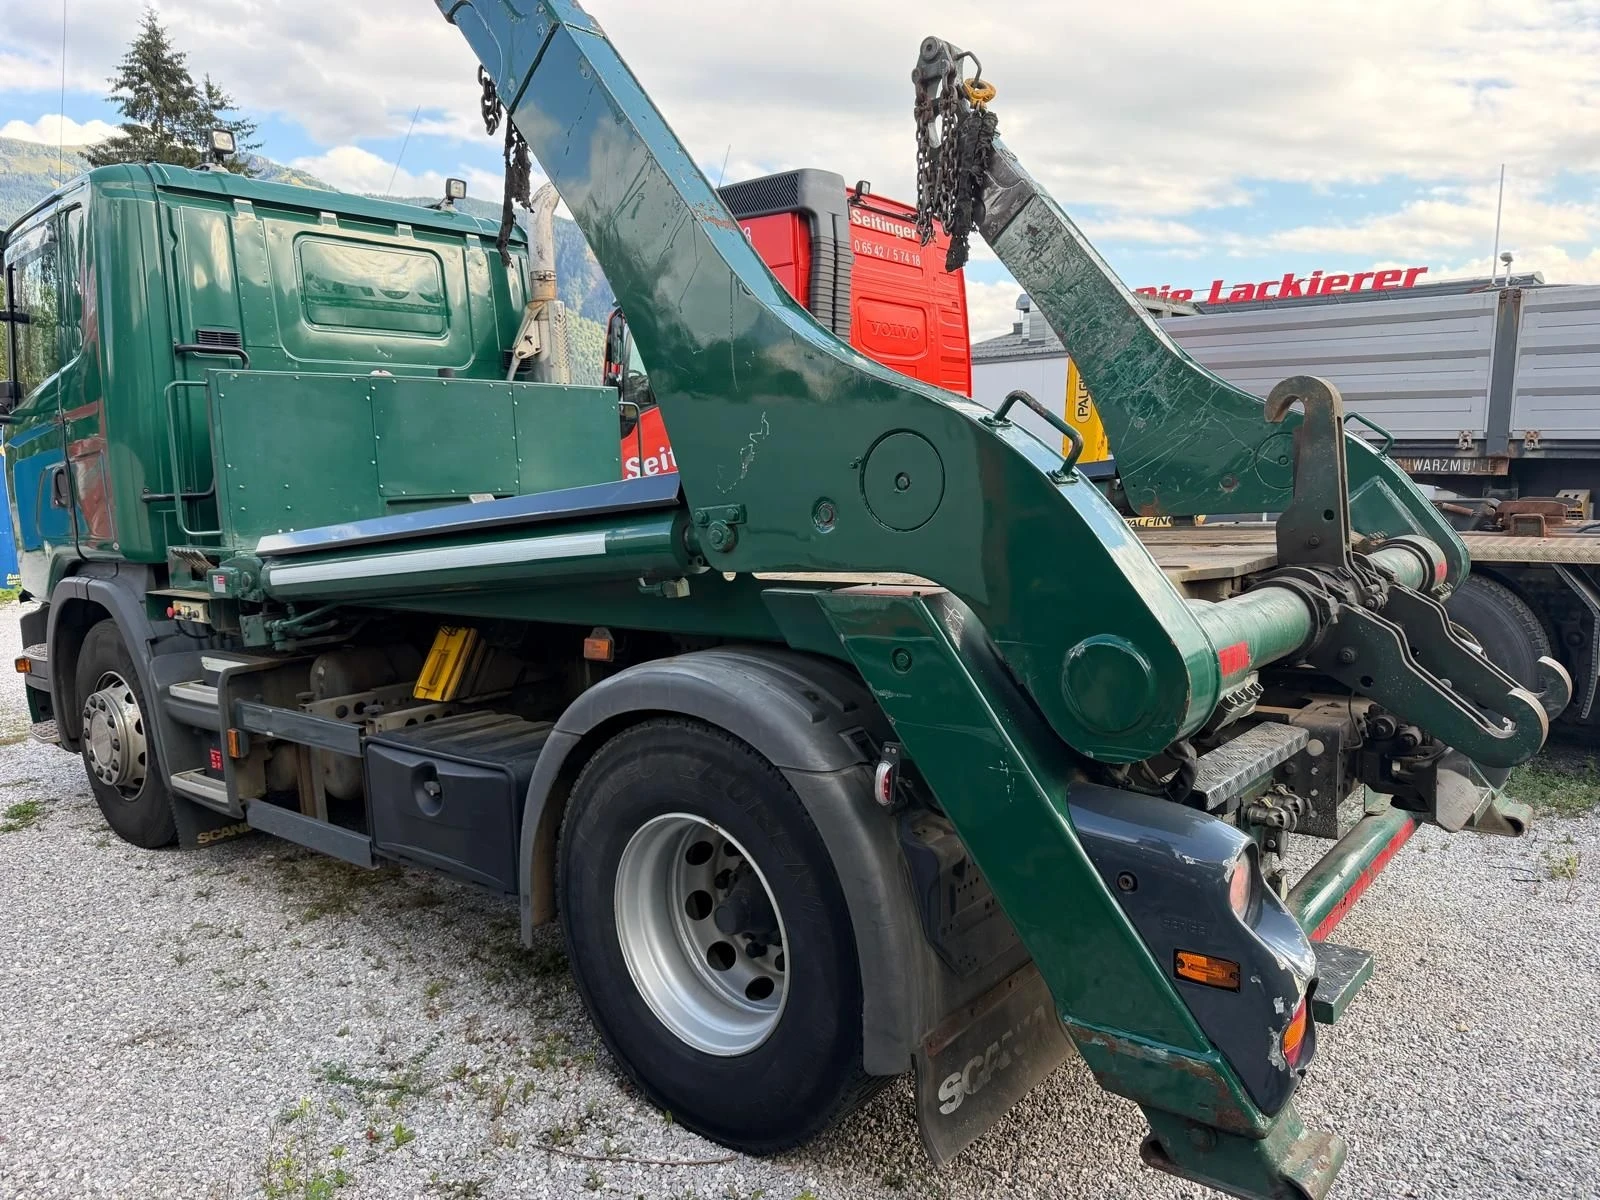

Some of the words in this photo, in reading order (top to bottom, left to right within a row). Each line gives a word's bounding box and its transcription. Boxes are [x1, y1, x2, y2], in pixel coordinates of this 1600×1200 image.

[852, 209, 917, 239] Seitinger
[854, 239, 860, 252] 0
[862, 241, 872, 255] 65
[874, 244, 884, 258] 42
[893, 249, 899, 261] 5
[901, 251, 910, 263] 74
[912, 254, 920, 266] 18
[1207, 266, 1428, 305] Lackierer
[868, 320, 920, 341] VOLVO
